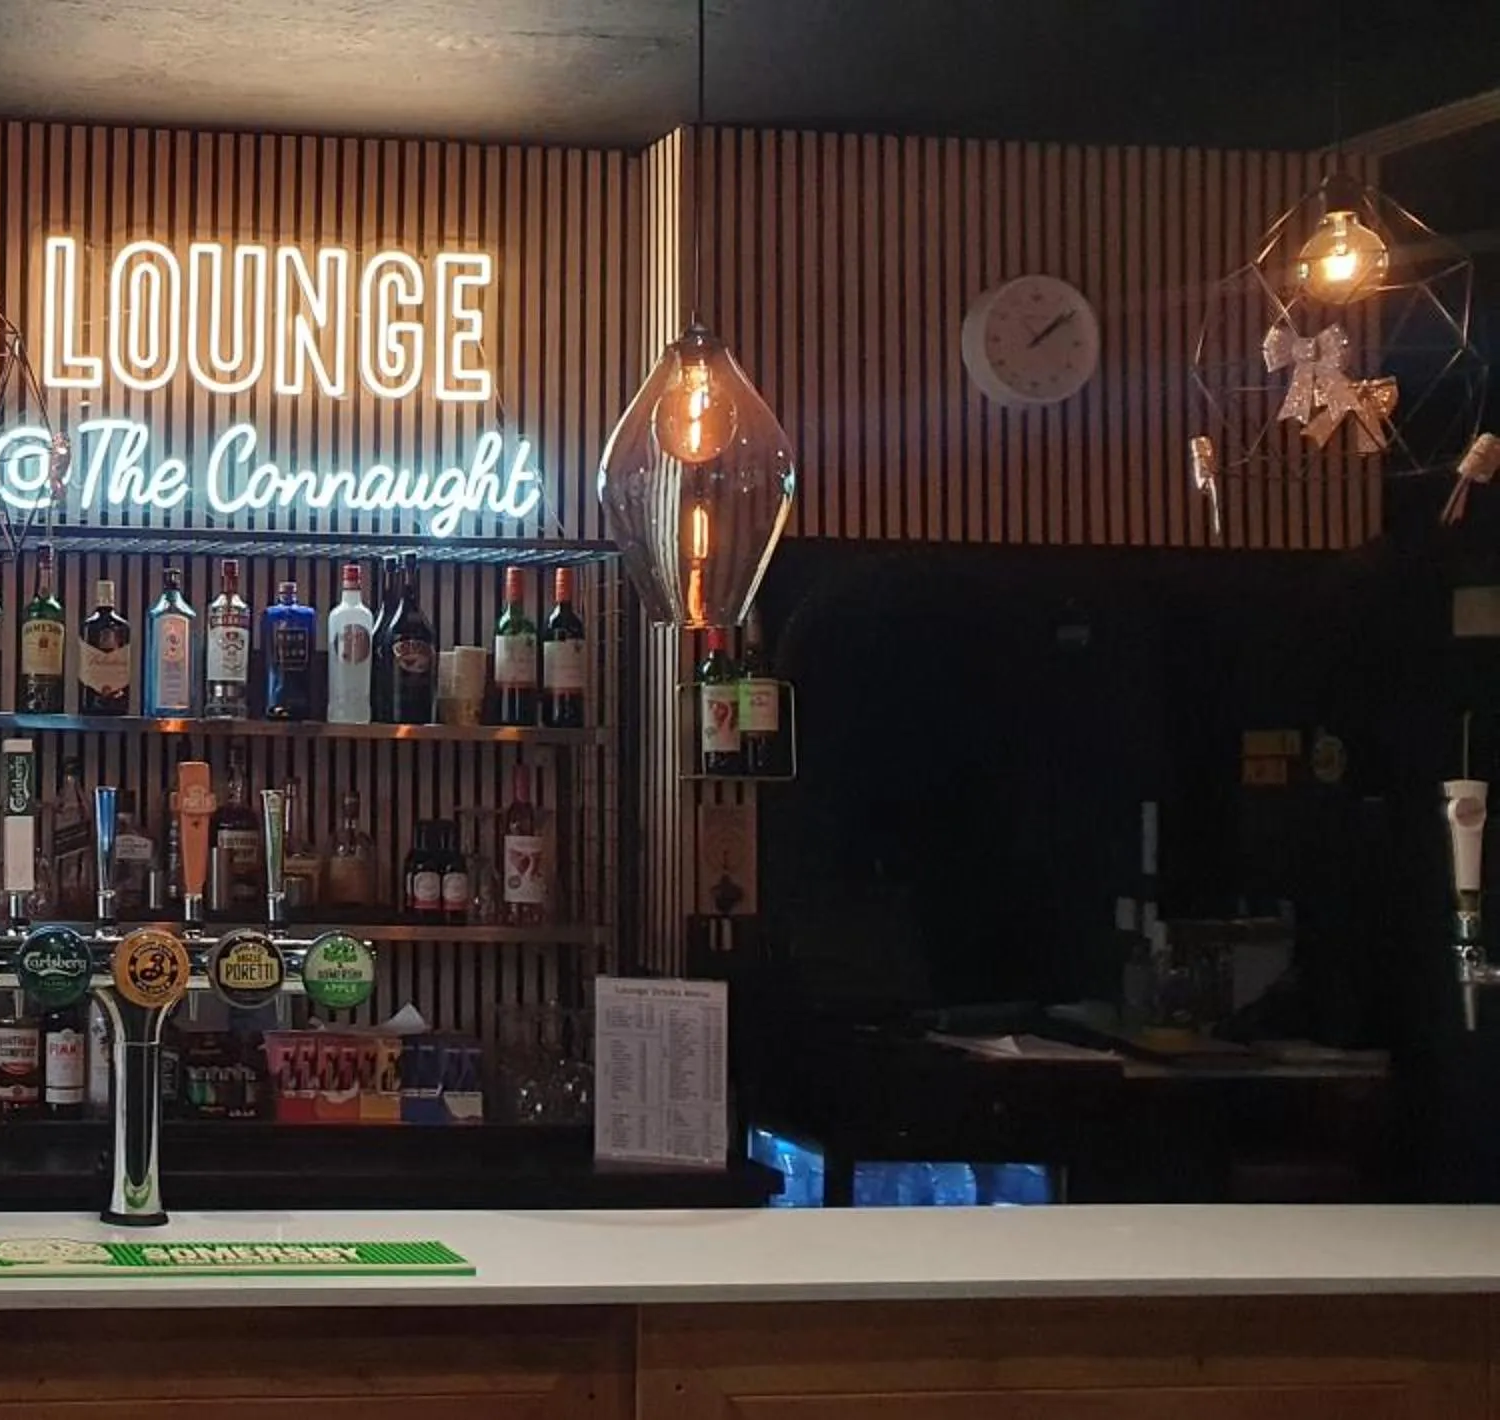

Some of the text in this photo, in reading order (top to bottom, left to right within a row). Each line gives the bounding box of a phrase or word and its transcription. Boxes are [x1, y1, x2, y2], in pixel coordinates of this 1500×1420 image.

[43, 236, 494, 401] LOUNGE
[78, 419, 193, 510] The
[207, 423, 541, 539] Connaught
[23, 951, 87, 977] Carlsberg
[225, 963, 274, 981] PORETTI
[141, 1246, 362, 1265] SOMERSBY
